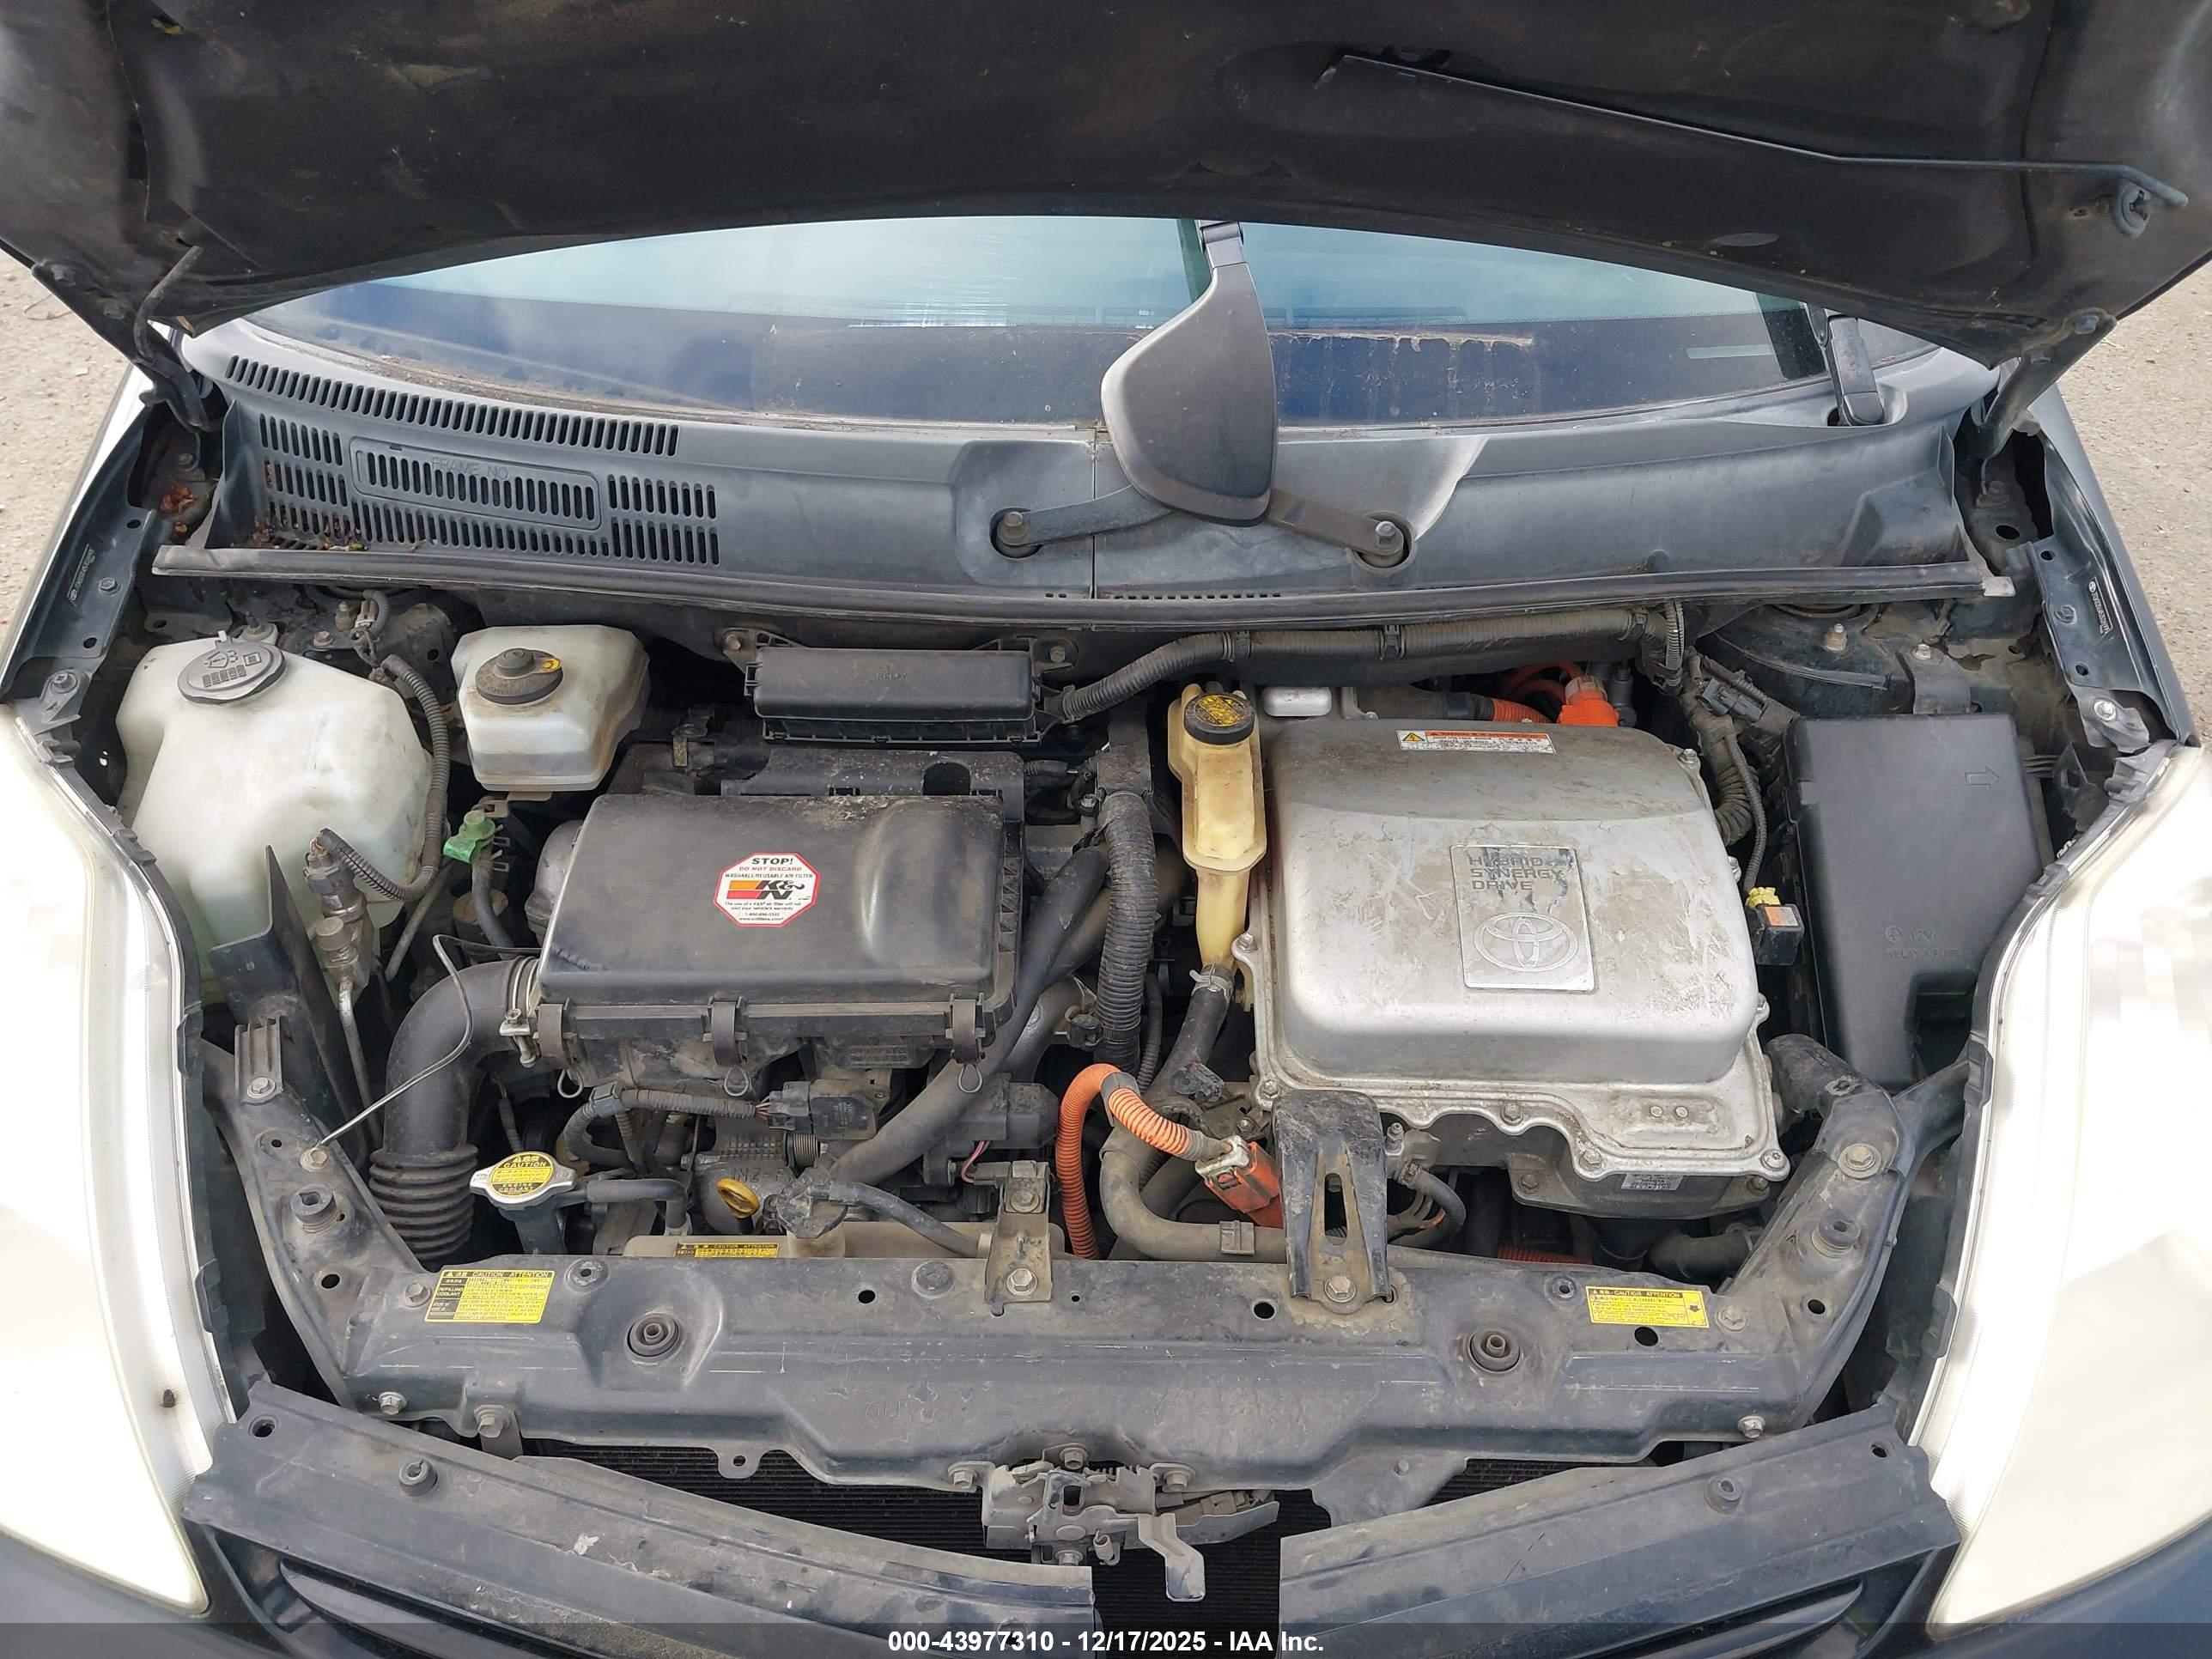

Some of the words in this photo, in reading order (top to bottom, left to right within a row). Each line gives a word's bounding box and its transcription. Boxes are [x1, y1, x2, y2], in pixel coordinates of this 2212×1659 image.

[1469, 856, 1544, 866] HYBRID
[1470, 867, 1563, 879] SYNERGY
[1472, 880, 1533, 890] DRIVE
